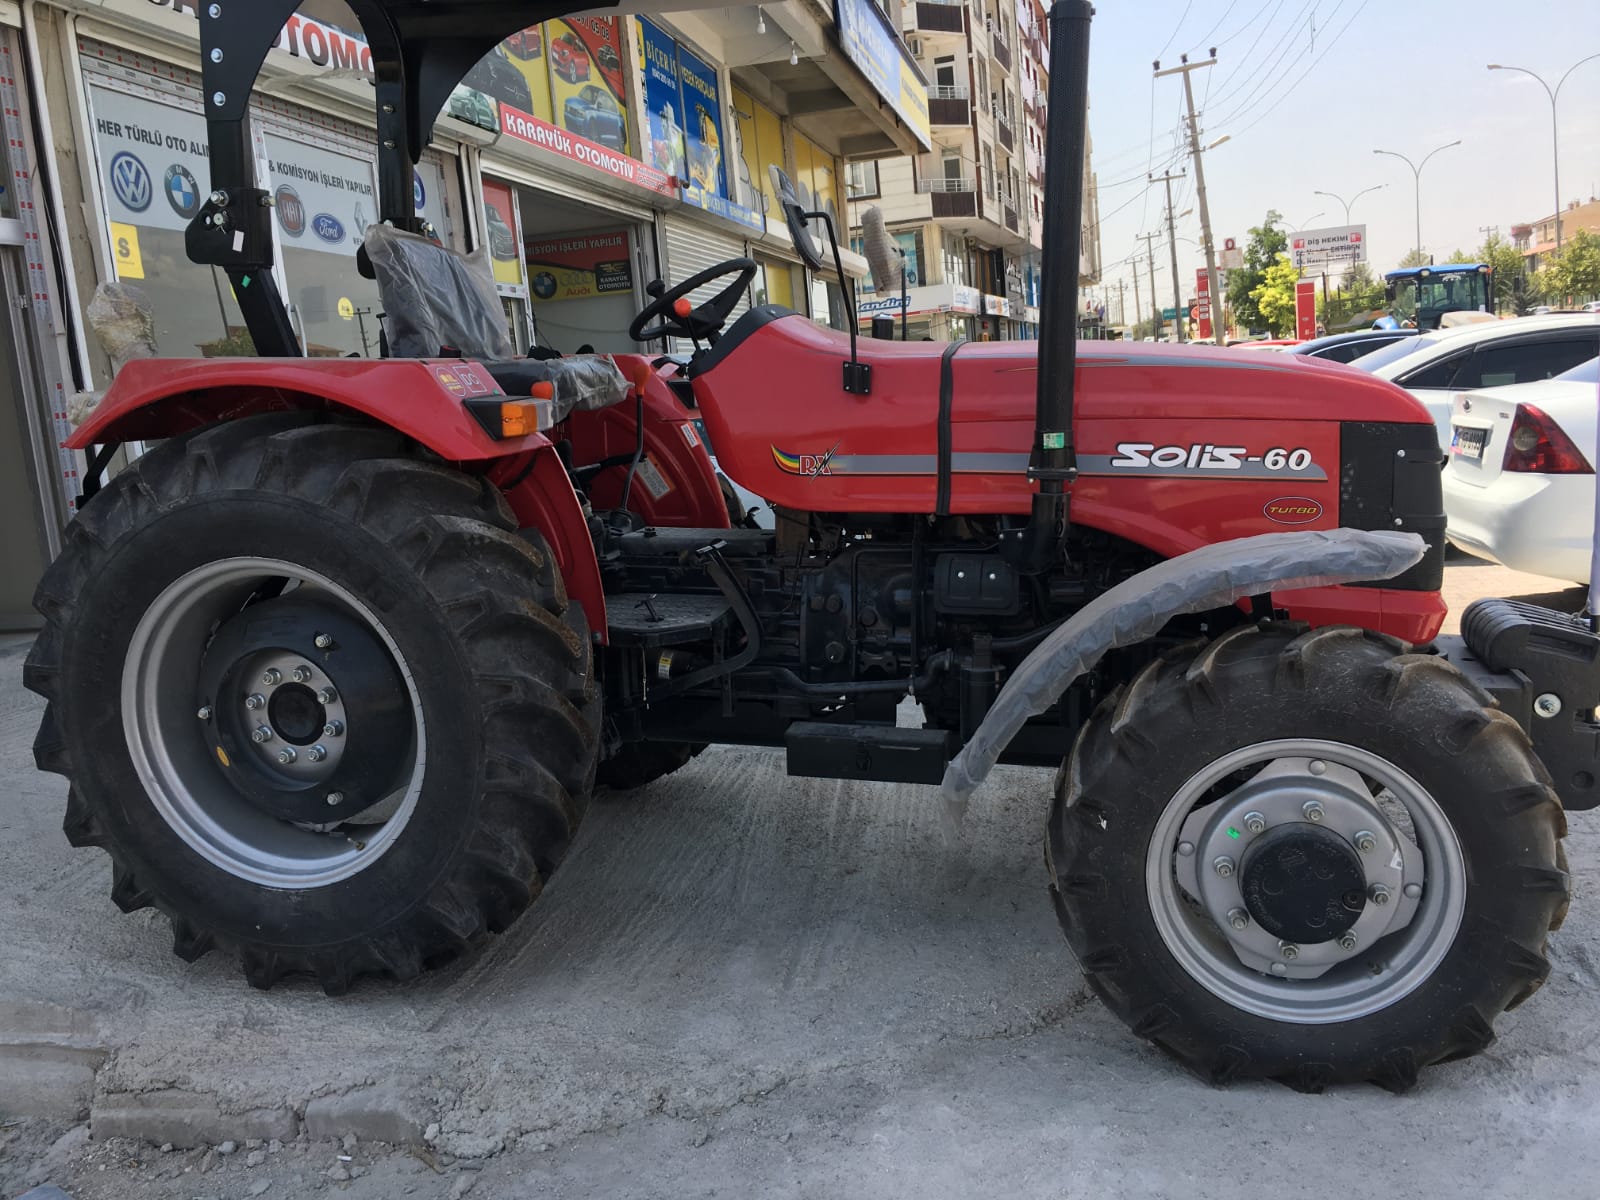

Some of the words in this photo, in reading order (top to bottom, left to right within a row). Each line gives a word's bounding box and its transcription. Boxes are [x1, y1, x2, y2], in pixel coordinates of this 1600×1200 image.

[271, 14, 376, 86] TOM
[97, 118, 123, 137] HER
[124, 124, 162, 146] TÜRLÜ
[165, 135, 187, 153] OTO
[505, 112, 571, 154] KARAYÜK
[574, 142, 633, 178] OTOMOTİV
[276, 161, 320, 183] KOMİSYON
[320, 170, 344, 189] İŞLERİ
[344, 179, 372, 196] YAPILIR
